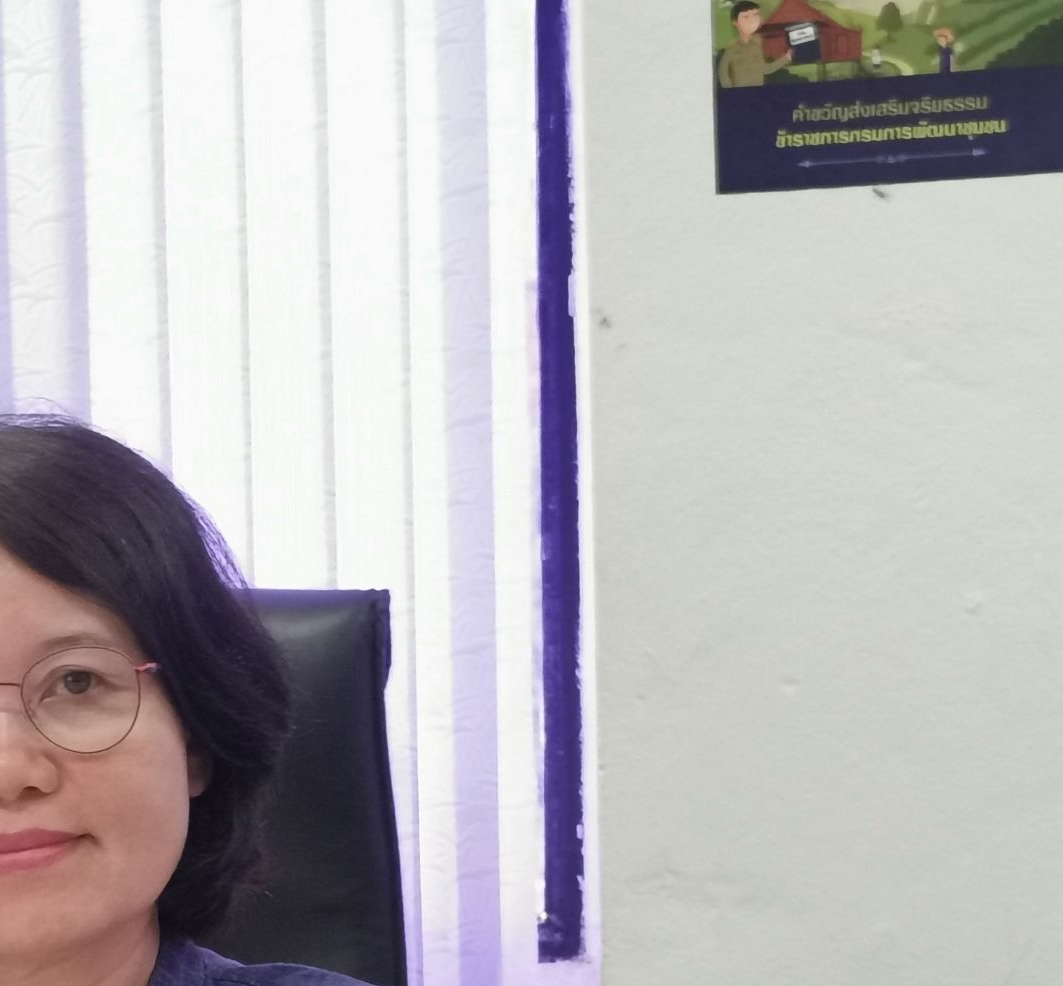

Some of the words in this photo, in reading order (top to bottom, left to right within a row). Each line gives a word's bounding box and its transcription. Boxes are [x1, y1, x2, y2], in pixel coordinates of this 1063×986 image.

[776, 119, 1006, 148] ข้าราชการกรมการพัฒนาชุมชน
